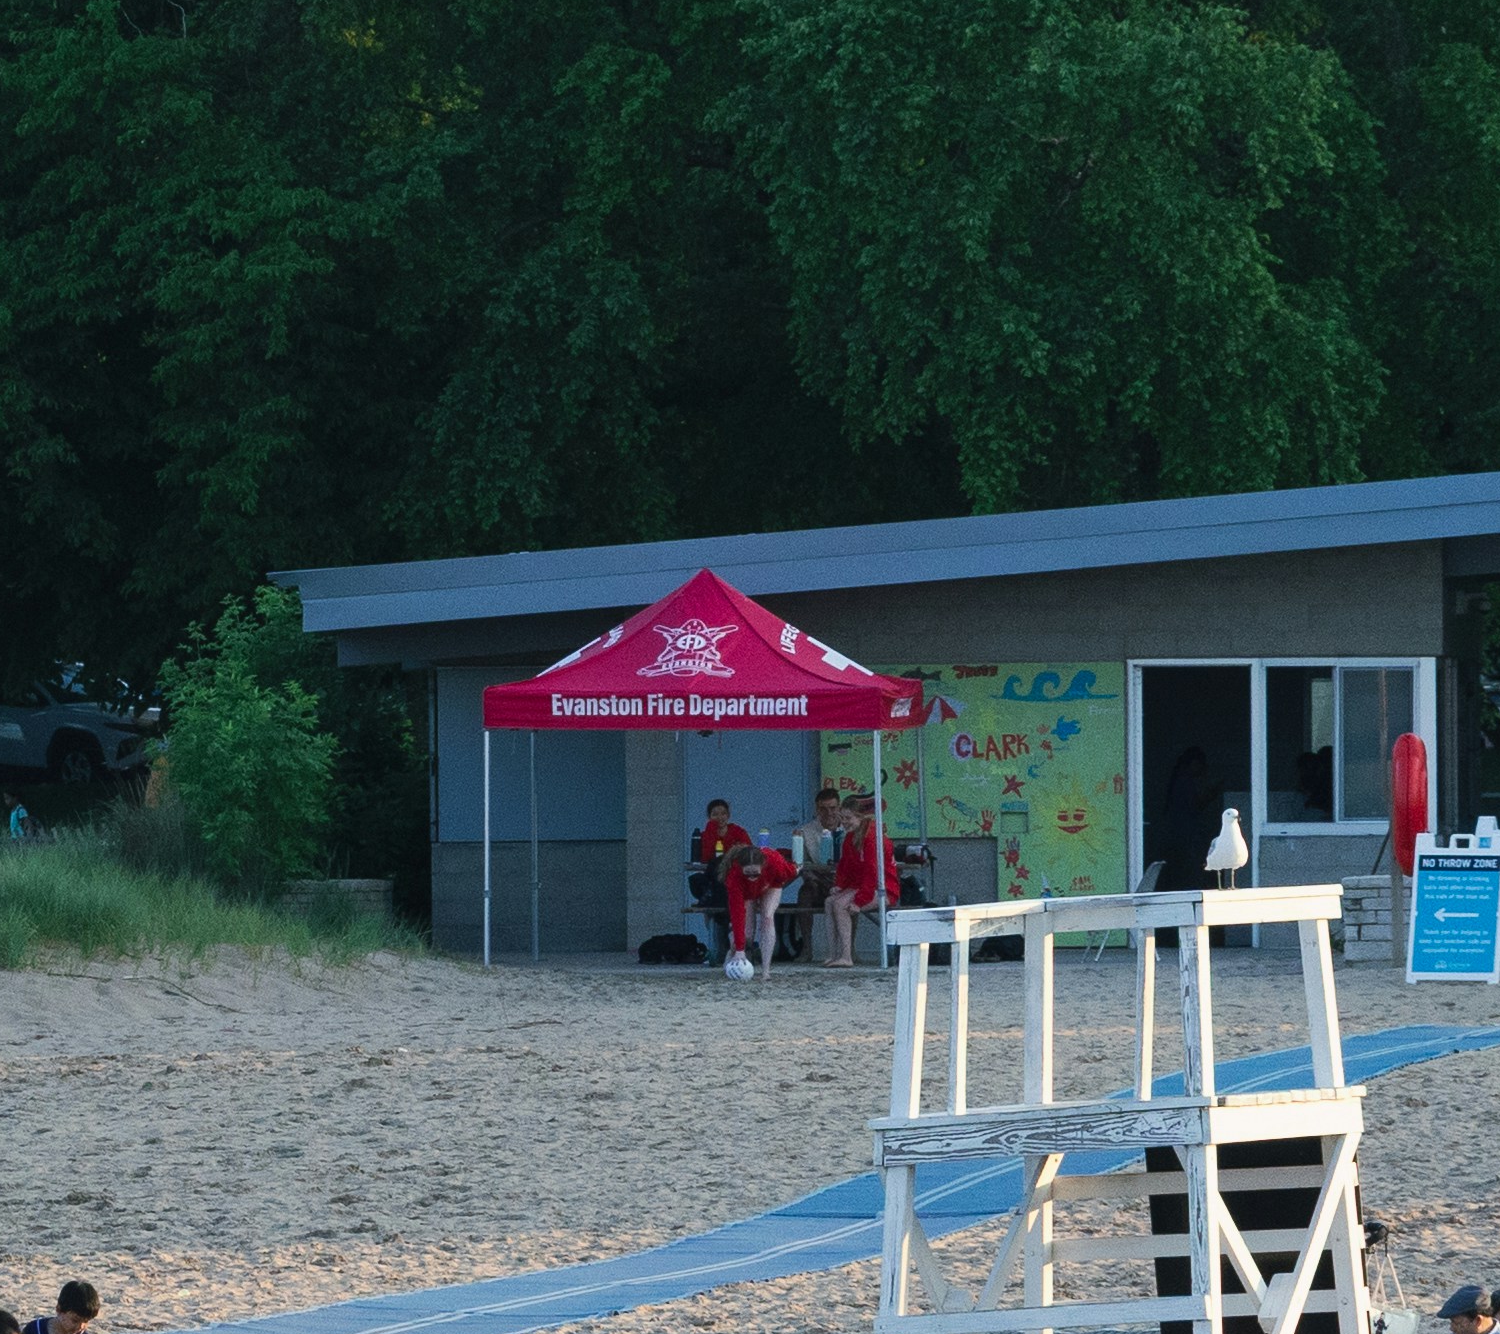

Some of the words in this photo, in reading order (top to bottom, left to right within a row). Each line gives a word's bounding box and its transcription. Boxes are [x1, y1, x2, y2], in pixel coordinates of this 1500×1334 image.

[677, 634, 707, 650] EFD
[551, 693, 643, 716] Evanston
[647, 693, 685, 716] Fire
[689, 694, 808, 721] Department
[954, 732, 1030, 762] CLARK
[1422, 858, 1436, 868] NO
[1438, 858, 1471, 868] THROW
[1473, 858, 1498, 868] ZONE
